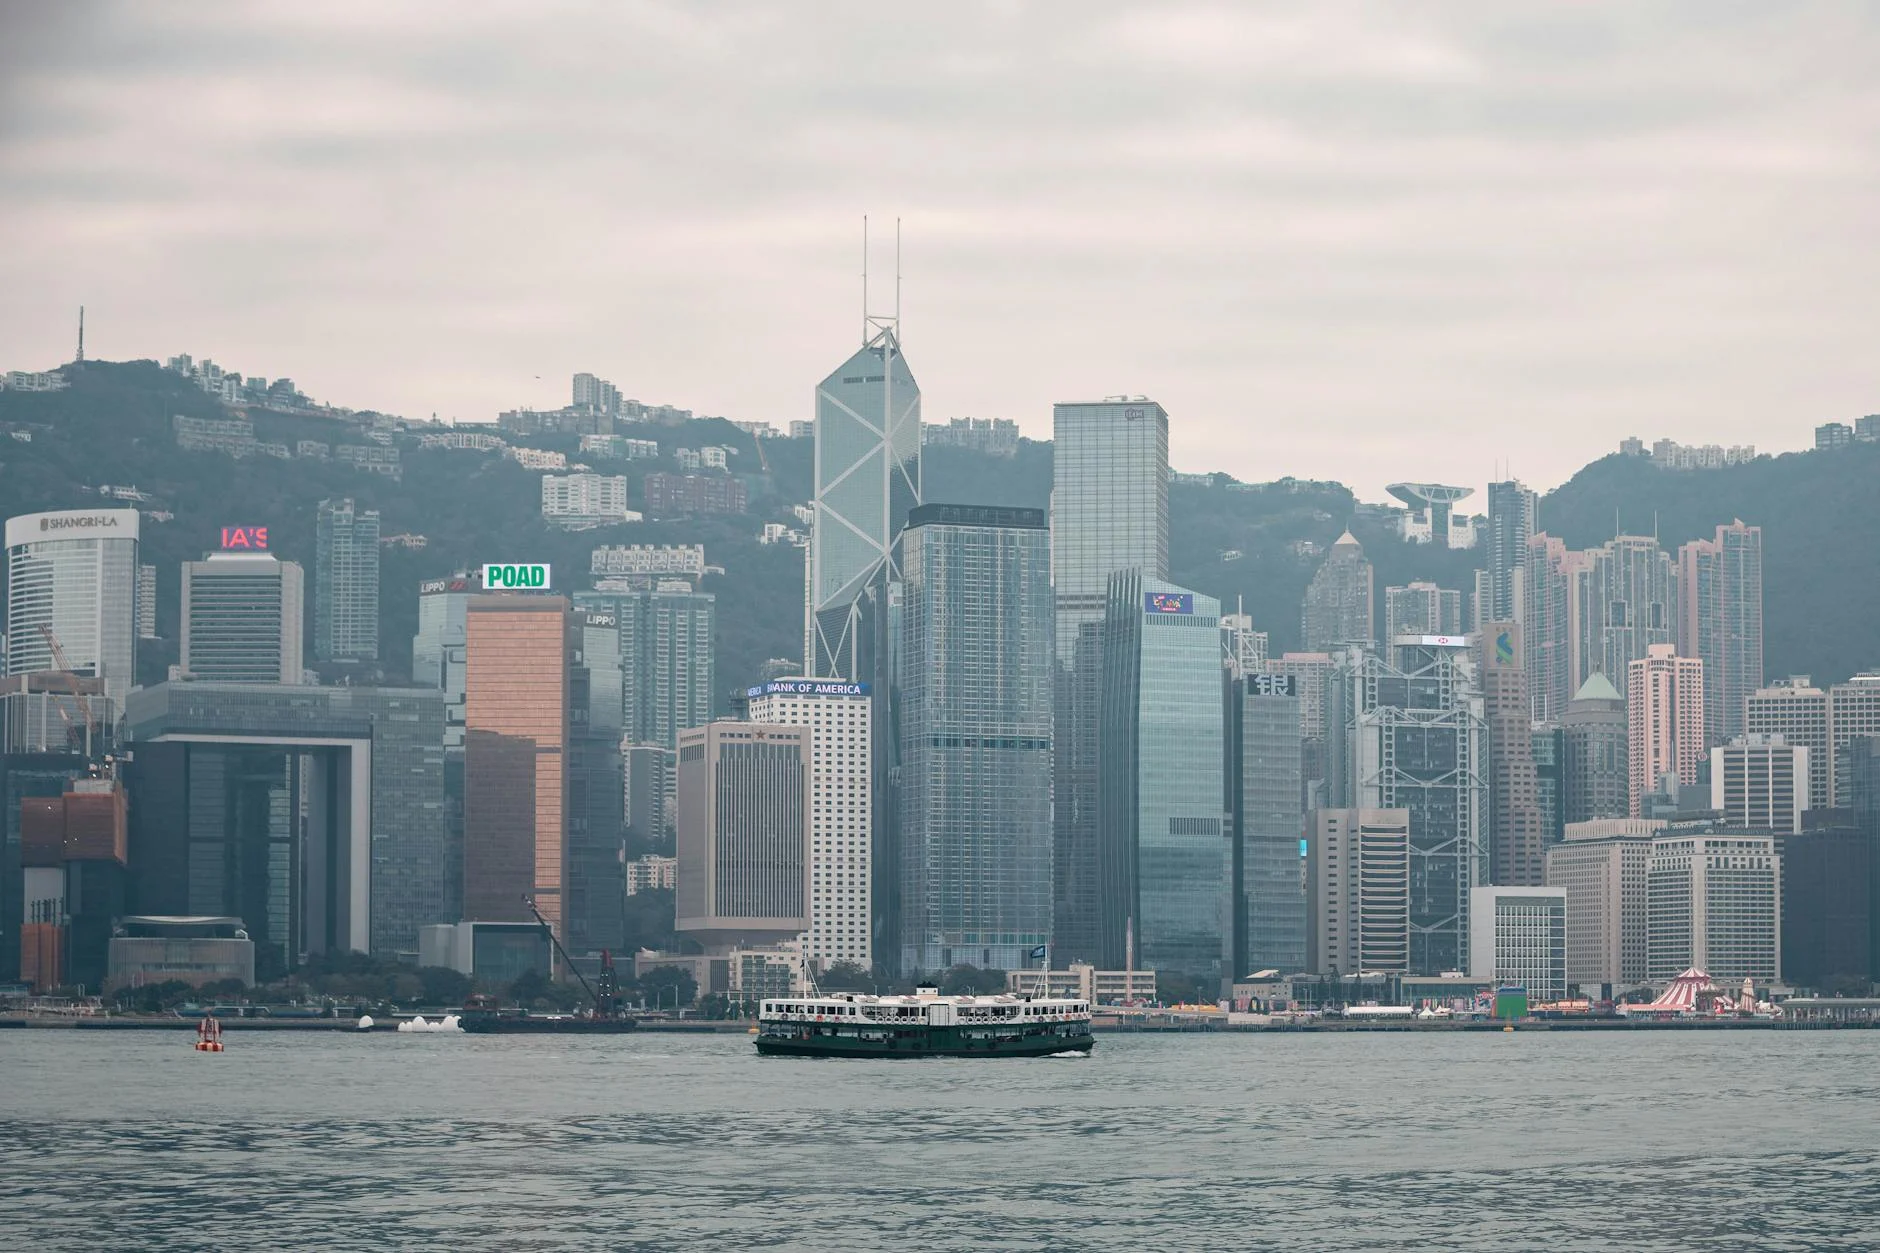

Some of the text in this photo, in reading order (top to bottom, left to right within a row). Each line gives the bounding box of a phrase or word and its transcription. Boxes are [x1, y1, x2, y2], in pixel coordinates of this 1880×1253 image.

[49, 516, 118, 529] SHANGRI-LA
[488, 565, 545, 587] POAD
[421, 581, 445, 593] LIPPO
[586, 615, 616, 626] LIPPO
[798, 683, 813, 693] OF
[815, 684, 861, 695] AMERICA
